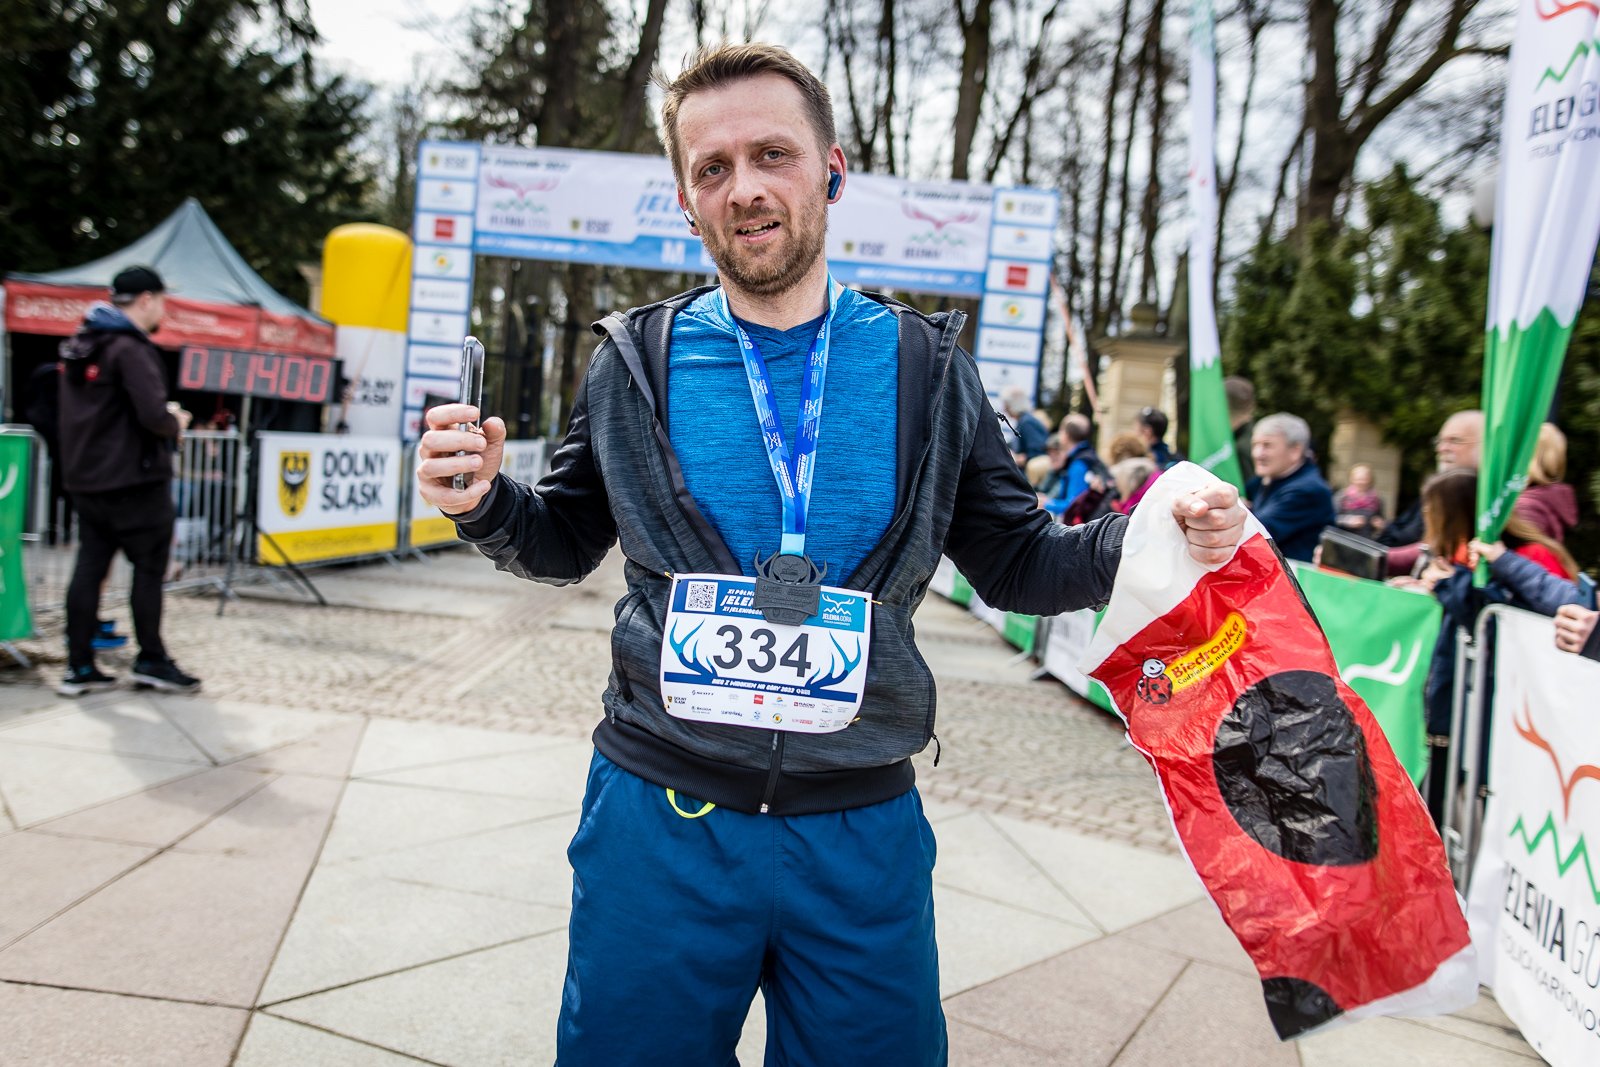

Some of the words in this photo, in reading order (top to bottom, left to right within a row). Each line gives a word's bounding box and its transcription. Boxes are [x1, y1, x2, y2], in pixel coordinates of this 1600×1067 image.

[322, 450, 389, 478] DOLNY
[321, 480, 383, 514] ŚLĄSK
[735, 588, 755, 597] PÓŁM
[713, 624, 812, 678] 334
[1172, 620, 1240, 679] Biedronka
[1503, 864, 1566, 962] ELENIA
